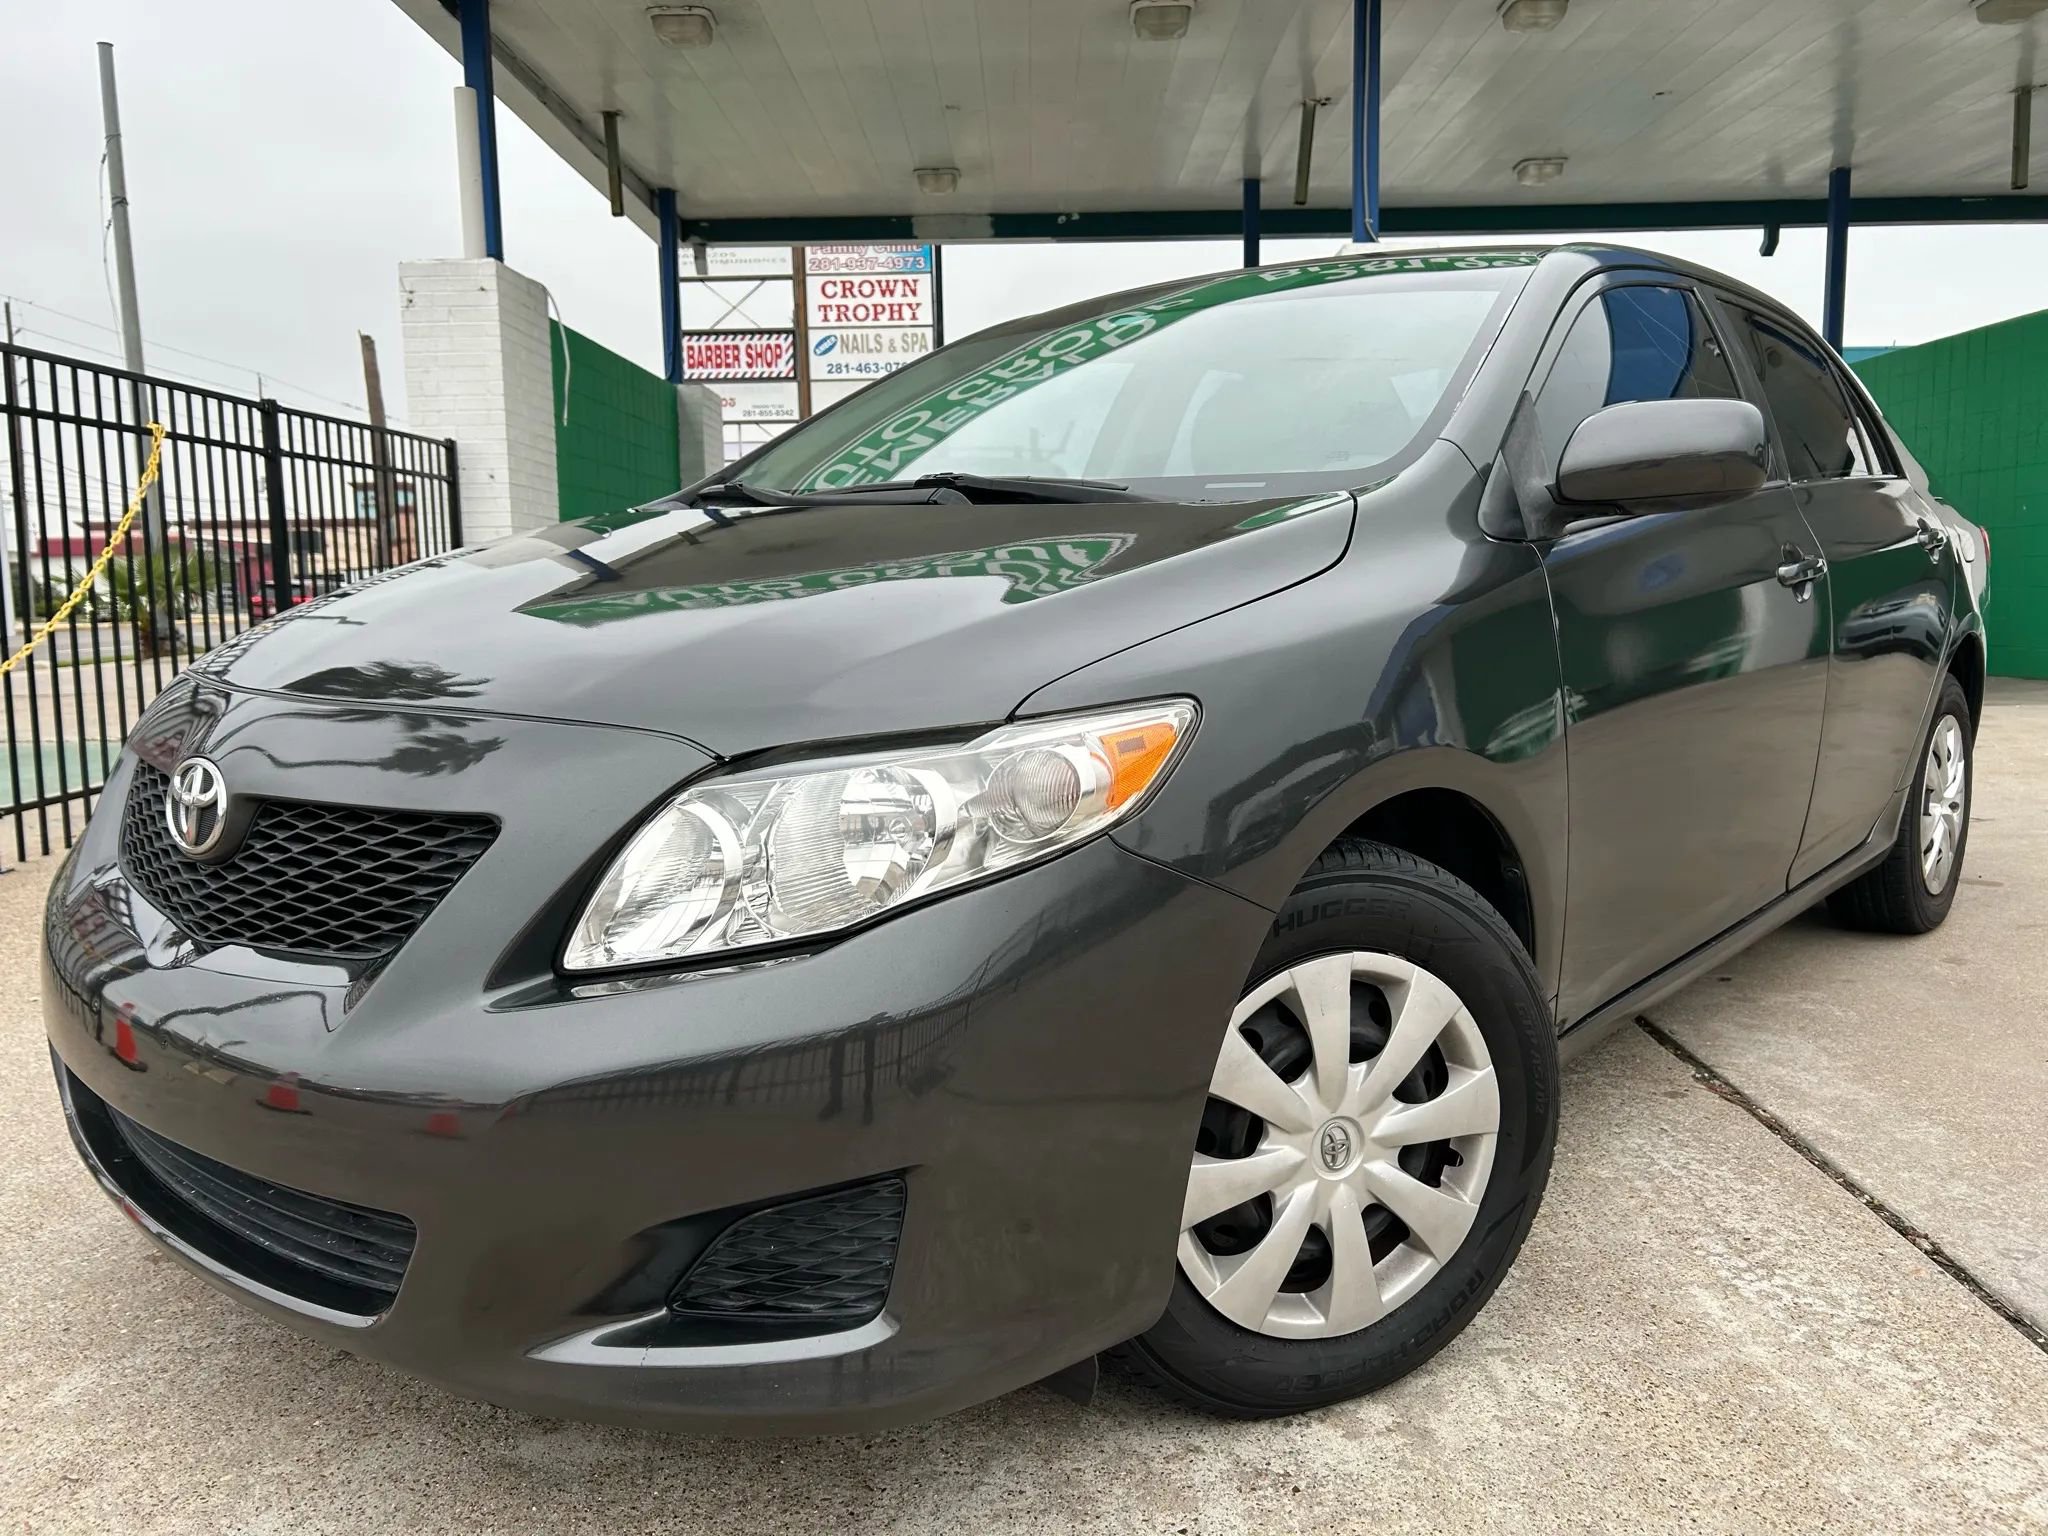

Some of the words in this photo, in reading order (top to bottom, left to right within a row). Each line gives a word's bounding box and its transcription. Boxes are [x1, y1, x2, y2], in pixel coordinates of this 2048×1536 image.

[809, 257, 926, 271] 281-937-4973
[820, 279, 919, 299] CROWN
[818, 303, 922, 322] TROPHY
[840, 333, 883, 355] NAILS
[888, 339, 898, 351] &
[901, 332, 929, 353] SPA
[687, 344, 741, 370] BARBER
[745, 342, 784, 368] SHOP
